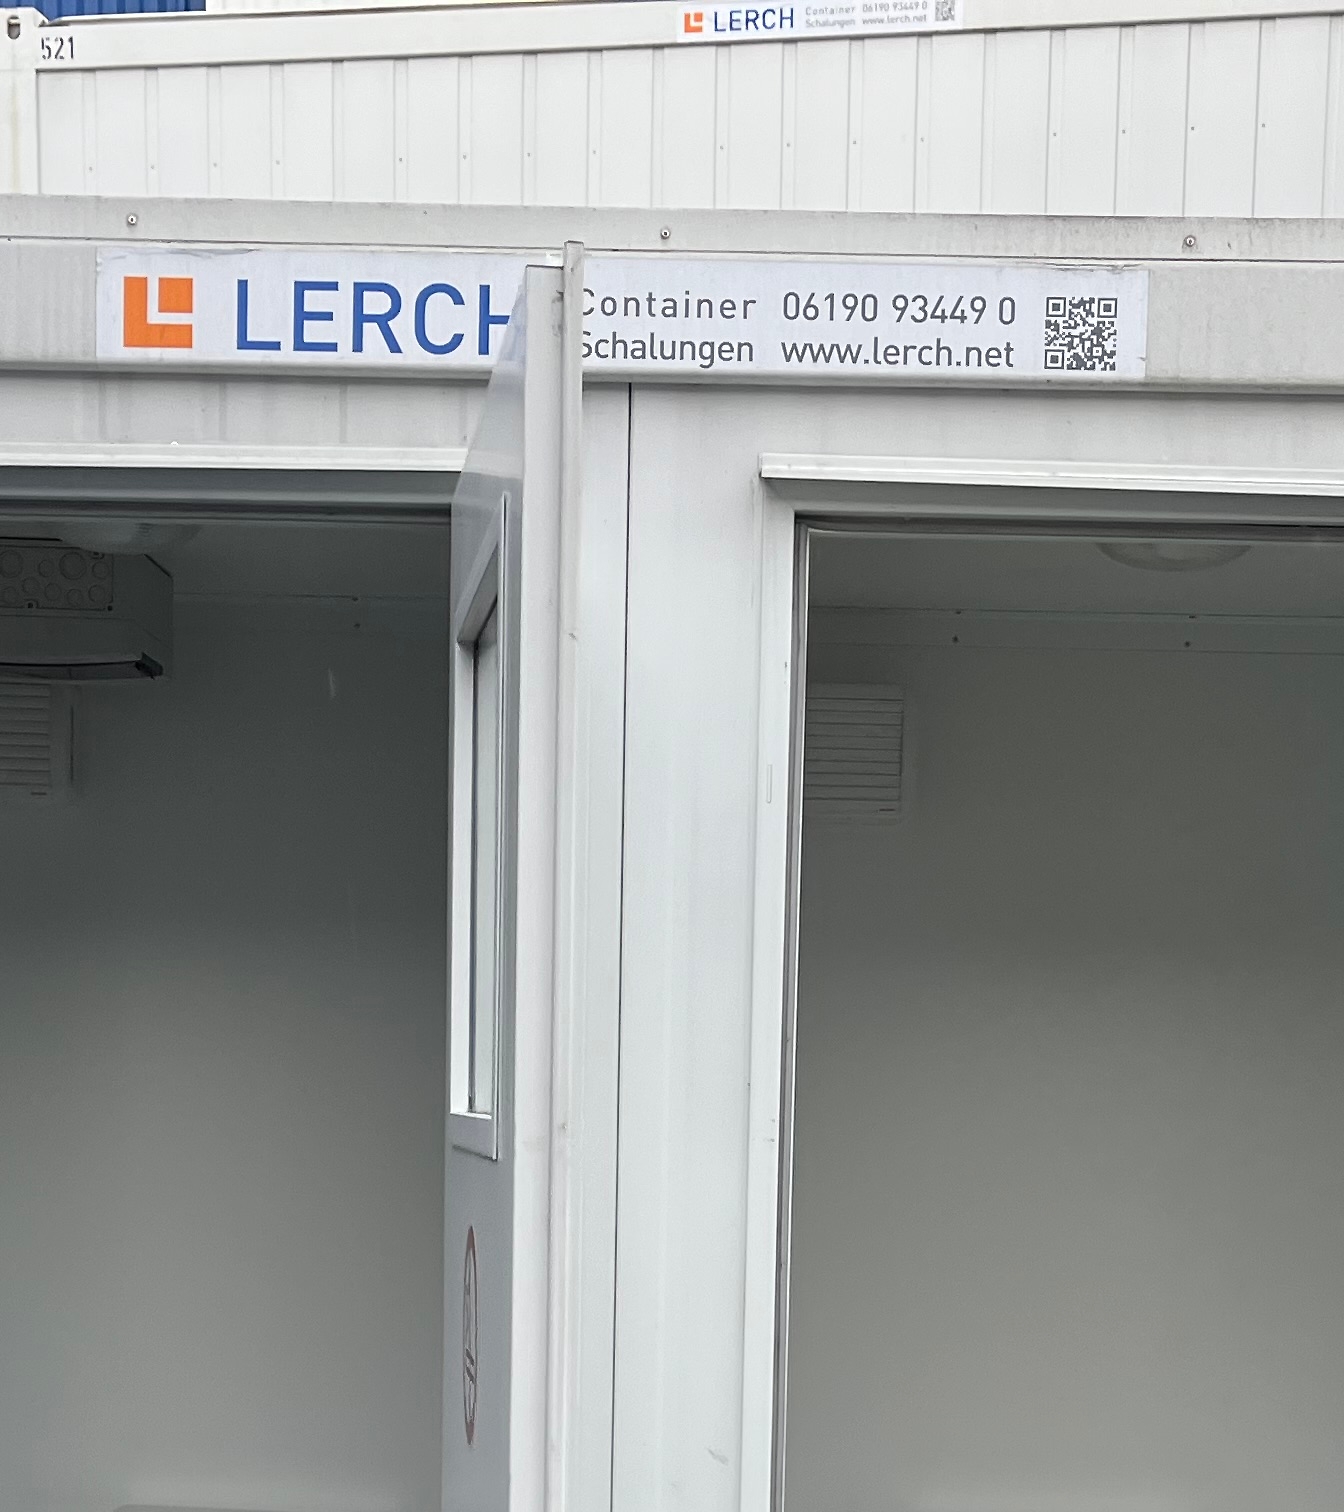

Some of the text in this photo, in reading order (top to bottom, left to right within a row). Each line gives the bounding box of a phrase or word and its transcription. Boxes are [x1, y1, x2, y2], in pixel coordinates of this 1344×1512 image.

[713, 7, 794, 32] LERCH
[805, 6, 856, 16] Container
[41, 36, 74, 60] 521
[782, 291, 879, 323] 06190
[891, 293, 987, 325] 93449
[998, 296, 1016, 326] 0
[780, 336, 1015, 368] www.lerch.net
